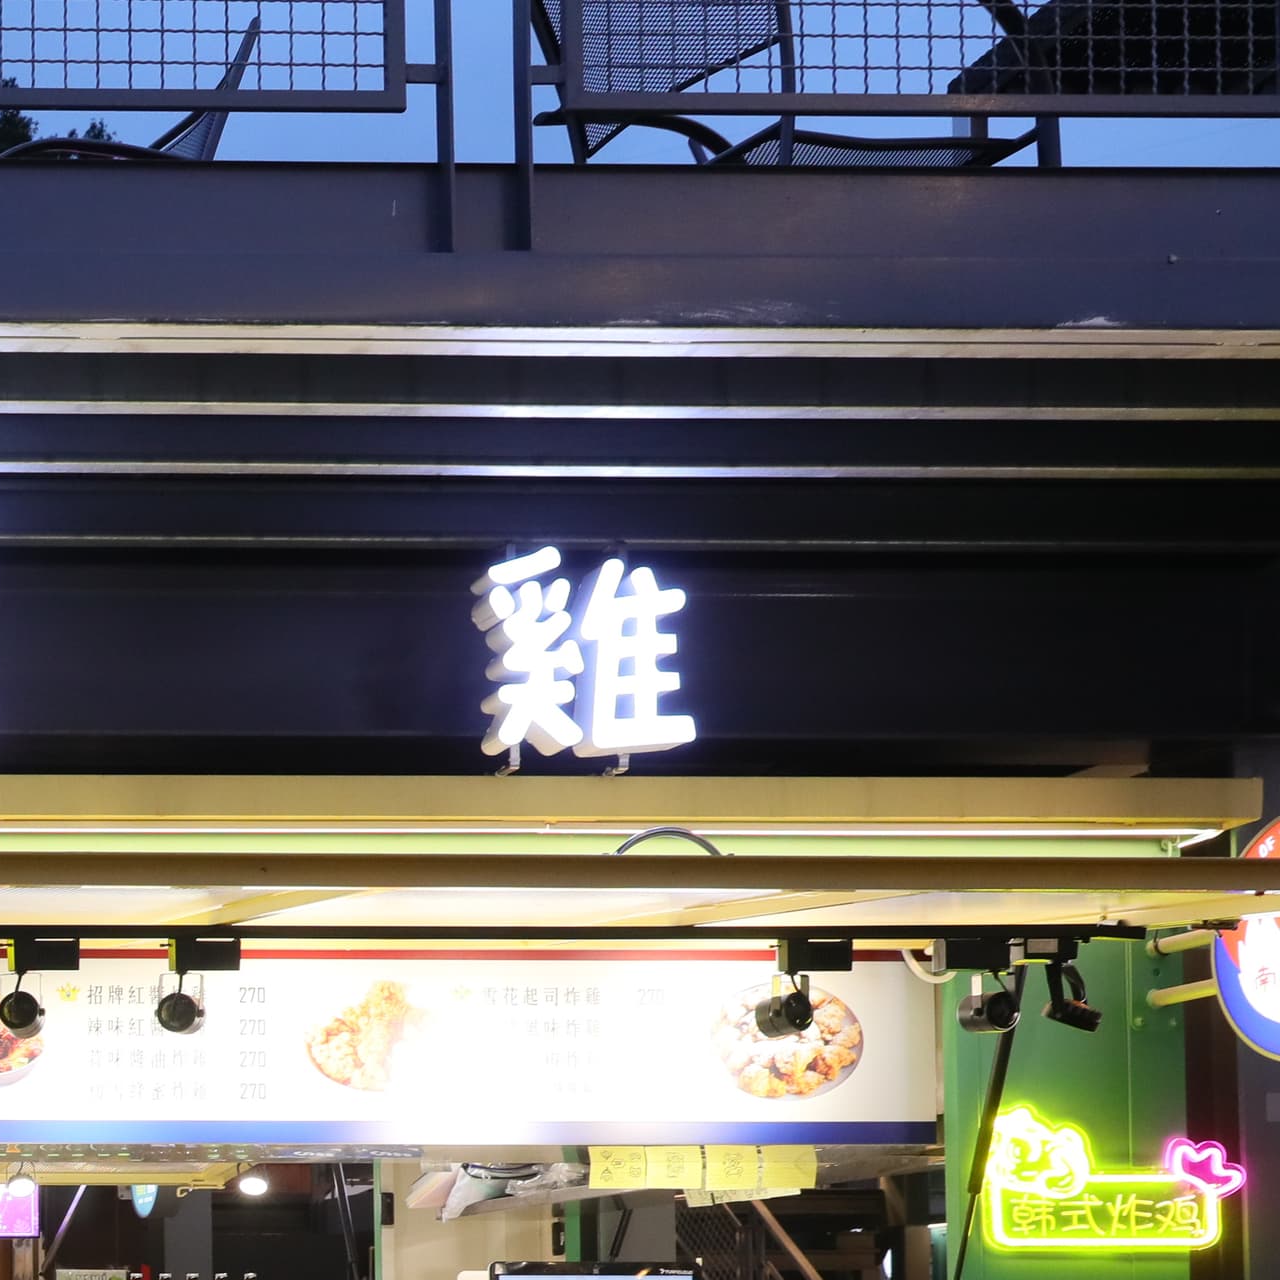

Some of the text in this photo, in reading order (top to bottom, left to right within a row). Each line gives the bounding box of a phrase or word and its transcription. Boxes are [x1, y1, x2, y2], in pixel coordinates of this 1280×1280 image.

[239, 987, 266, 1004] 270
[239, 1019, 266, 1036] 270
[240, 1051, 266, 1068] 270
[240, 1083, 267, 1100] 270
[1010, 1193, 1206, 1238] 韩式炸鸡
